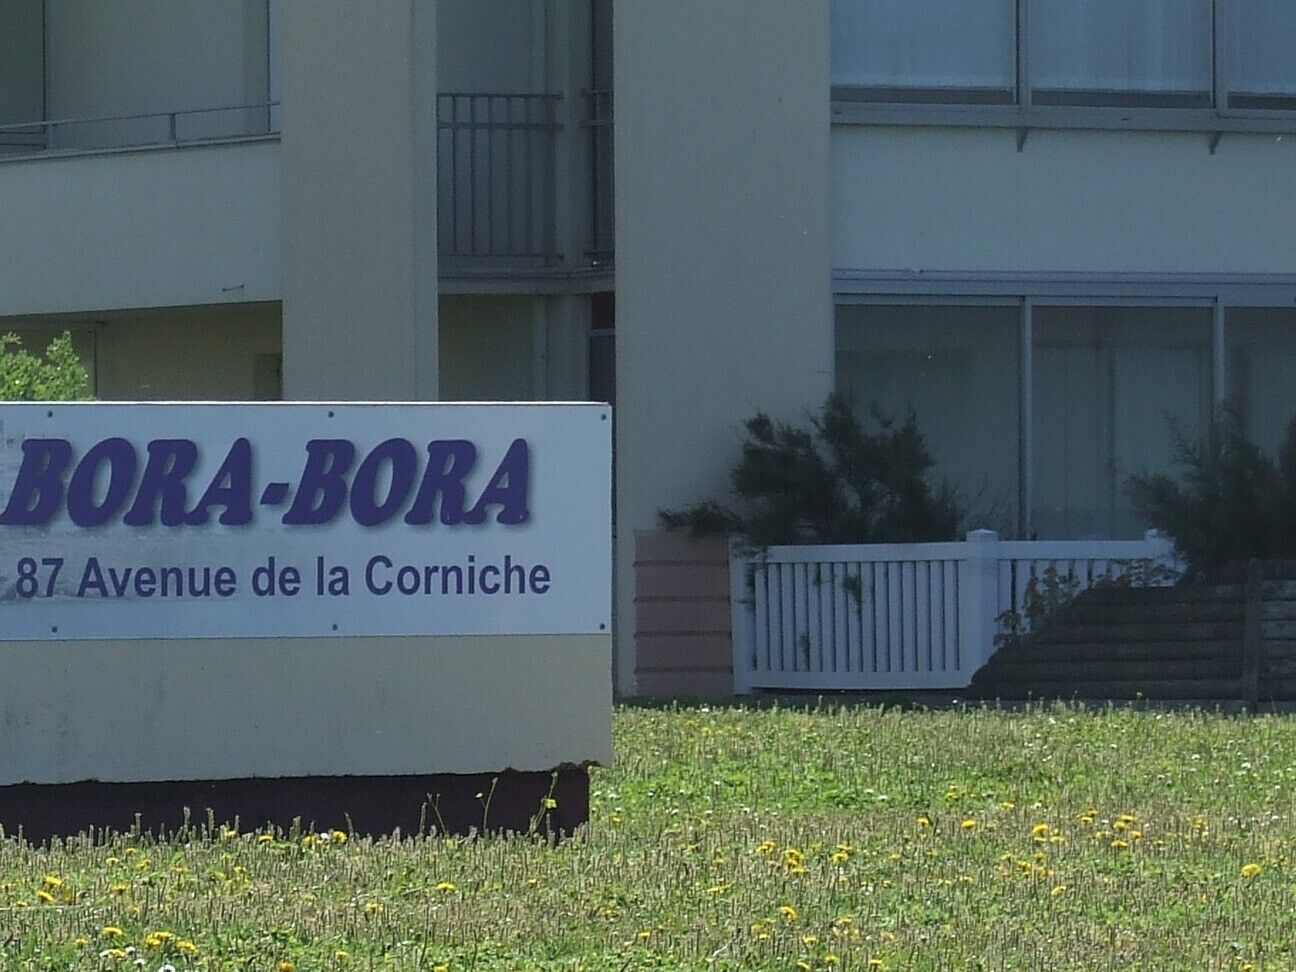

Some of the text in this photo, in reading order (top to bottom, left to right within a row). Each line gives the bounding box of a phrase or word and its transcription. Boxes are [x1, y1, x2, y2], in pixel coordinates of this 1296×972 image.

[16, 554, 551, 598] 87 Avenue de la Corniche
